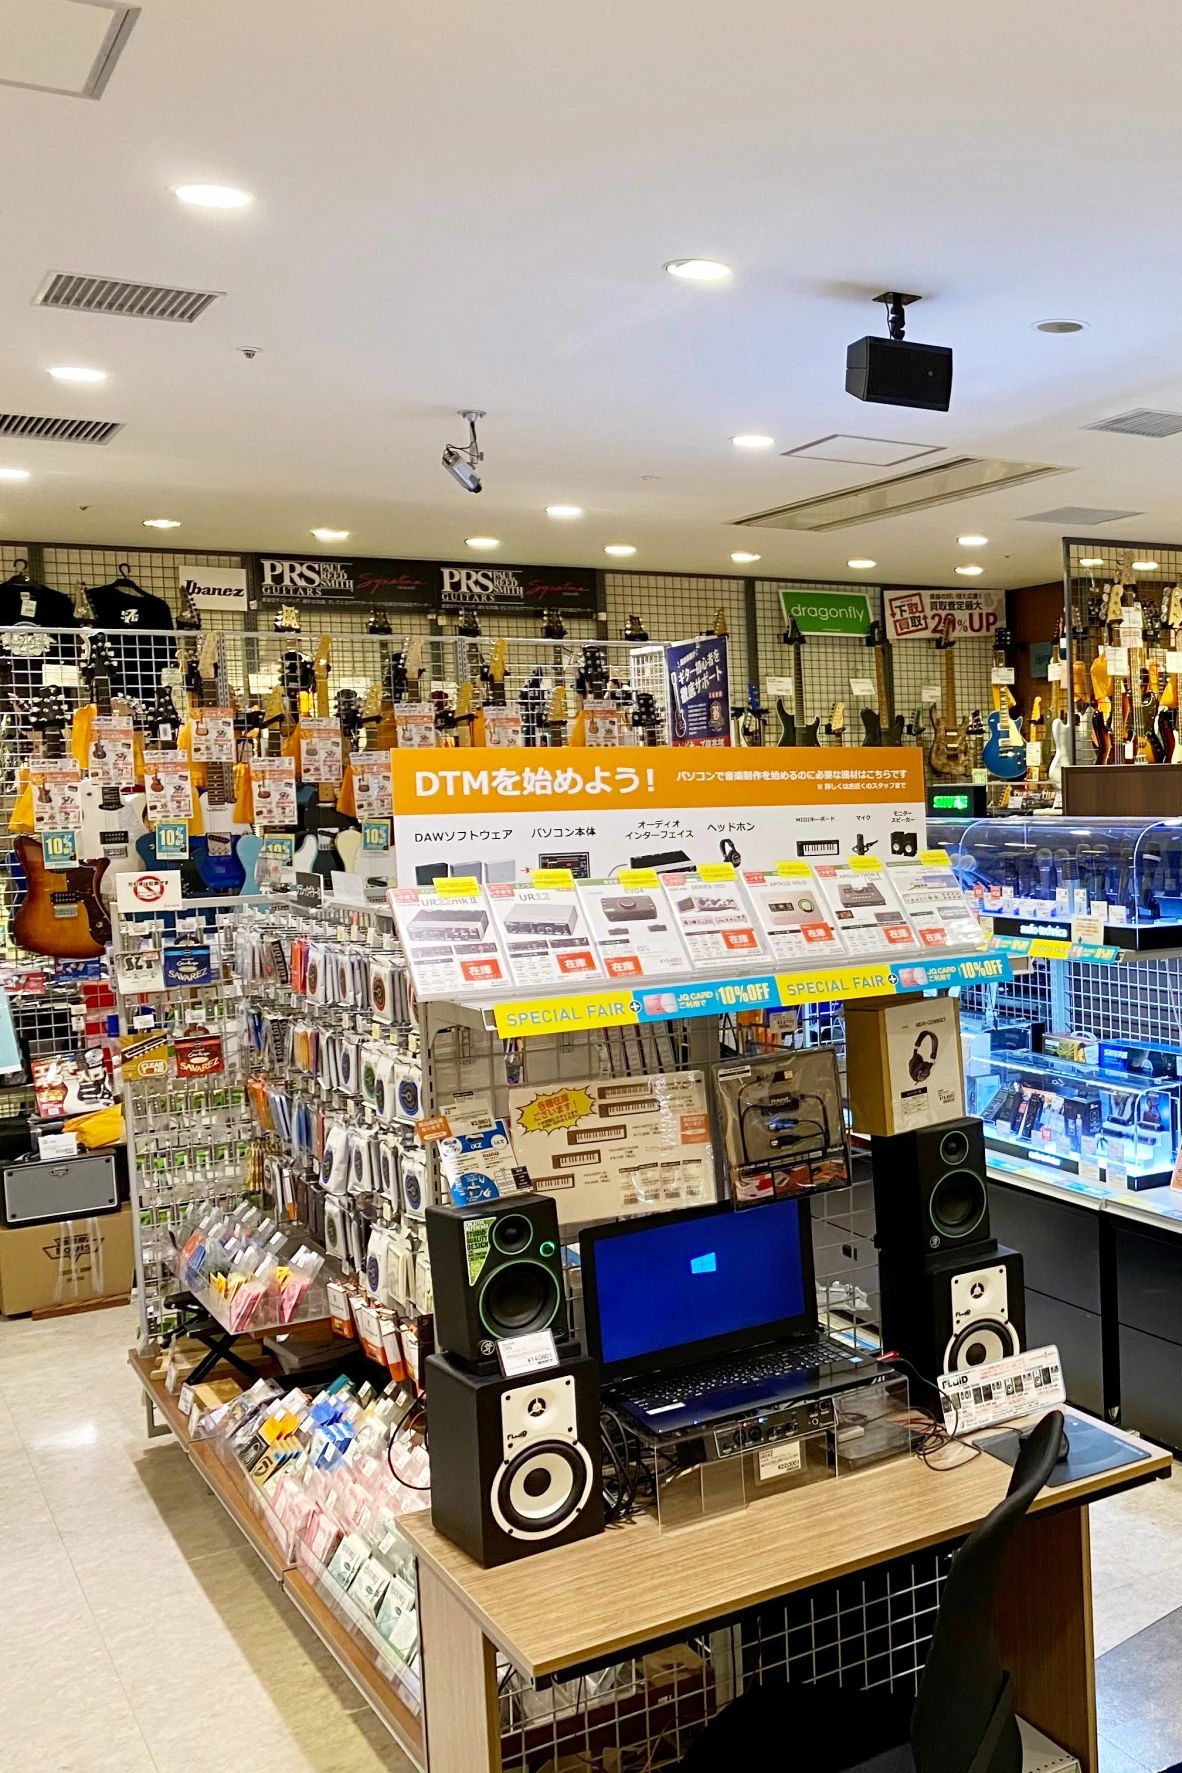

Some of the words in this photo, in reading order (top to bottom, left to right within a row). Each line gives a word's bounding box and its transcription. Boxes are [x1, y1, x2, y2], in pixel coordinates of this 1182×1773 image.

[320, 563, 343, 572] PAUL
[261, 560, 320, 587] PRS
[320, 571, 348, 580] REED
[494, 571, 515, 580] PAUL
[320, 579, 353, 589] SMITH
[441, 569, 494, 593] PRS
[494, 579, 518, 587] REED
[185, 579, 244, 597] Ibanez
[261, 586, 322, 597] GUITARS
[494, 586, 524, 595] SMITH
[441, 592, 495, 602] GUITARS
[790, 603, 864, 622] dragonfly
[895, 602, 919, 618] 下取
[415, 766, 656, 797] DTMを始めよう!
[637, 819, 680, 829] オーディオ
[707, 821, 756, 832] ヘッドホン
[414, 829, 512, 843] DAWソフトウェア
[531, 826, 597, 839] パソコン本体
[625, 829, 694, 840] インターフェイス
[727, 934, 750, 944] 在庫
[564, 959, 587, 969] 在庫
[611, 961, 635, 972] 在庫
[959, 959, 1003, 979] 10%OFF
[168, 967, 208, 981] SAVAREZ
[468, 965, 494, 976] 在庫
[787, 979, 849, 996] SPECIAL
[854, 975, 886, 989] FAIR
[690, 991, 714, 1000] CARD
[718, 982, 770, 1005] 10%OFF
[506, 1009, 581, 1027] SPECIAL
[587, 1003, 625, 1018] FAIR
[179, 1057, 220, 1073] SAVAREZ
